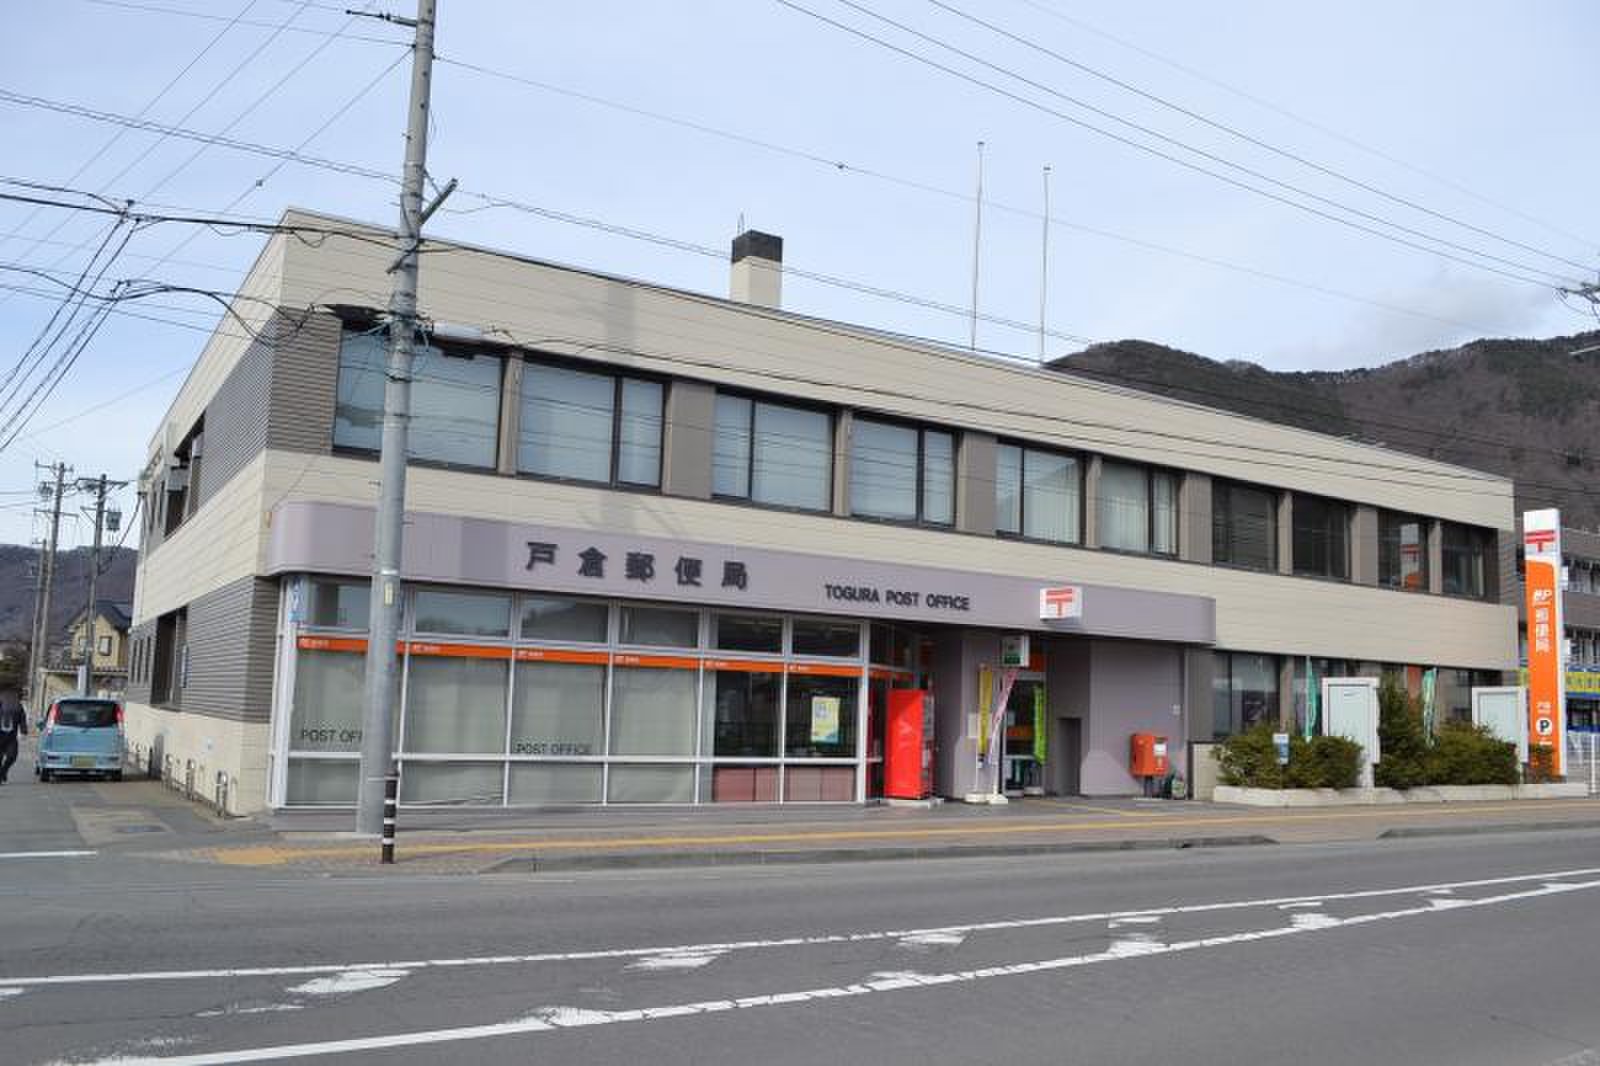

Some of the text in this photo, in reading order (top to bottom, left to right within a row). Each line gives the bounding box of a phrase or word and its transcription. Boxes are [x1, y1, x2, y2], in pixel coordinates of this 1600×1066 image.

[525, 541, 748, 590] 戸倉郵便局
[825, 584, 970, 611] TOGURA POST OFFICE
[302, 728, 336, 743] POST
